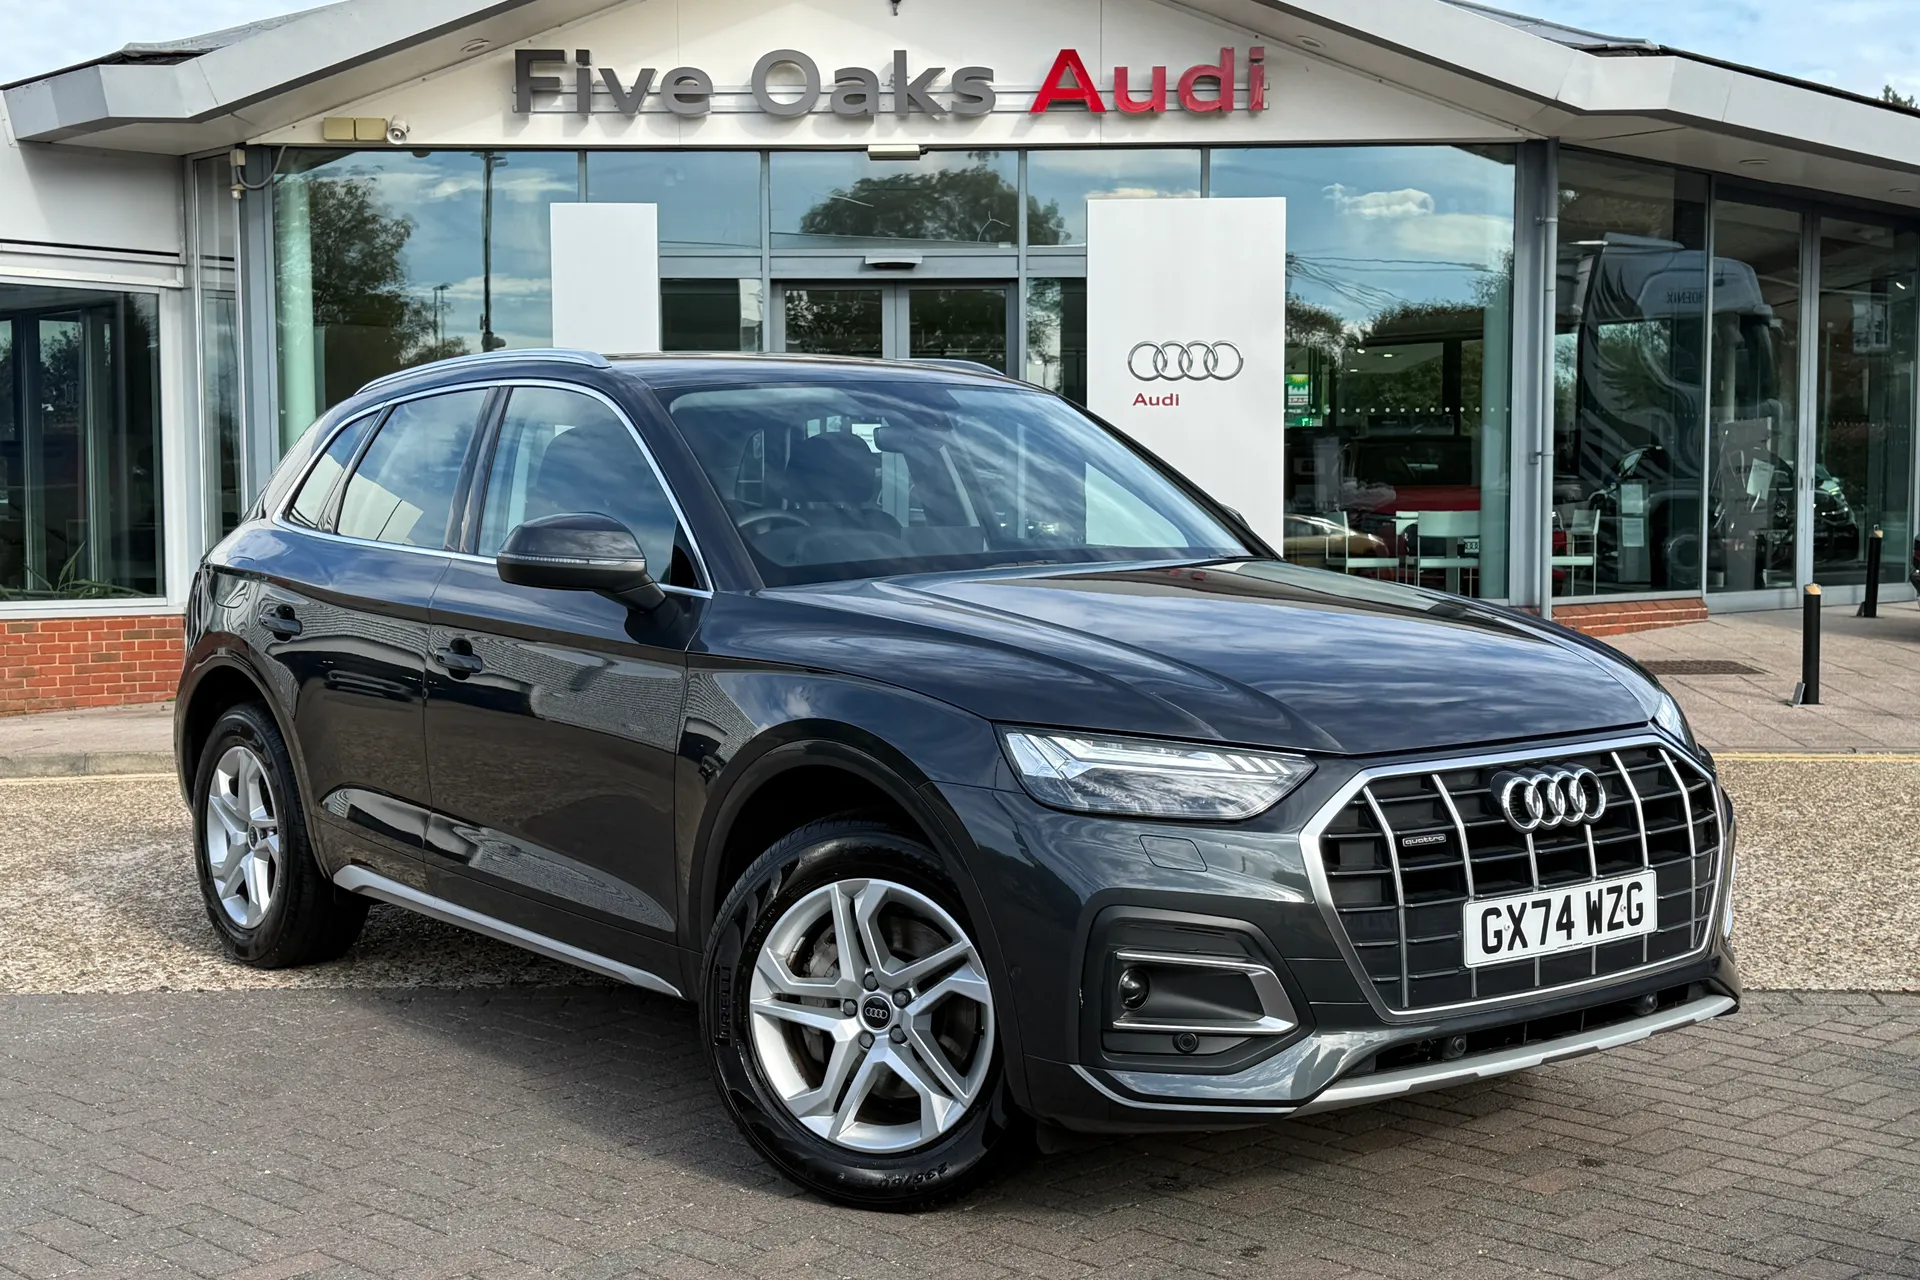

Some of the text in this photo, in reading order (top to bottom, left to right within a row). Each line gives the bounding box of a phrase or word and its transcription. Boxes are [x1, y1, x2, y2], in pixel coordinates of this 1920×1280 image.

[514, 46, 1265, 118] Five Oaks Audi
[1132, 393, 1179, 406] Audi
[1405, 835, 1445, 846] quattro
[1481, 881, 1644, 955] GX74 WZG
